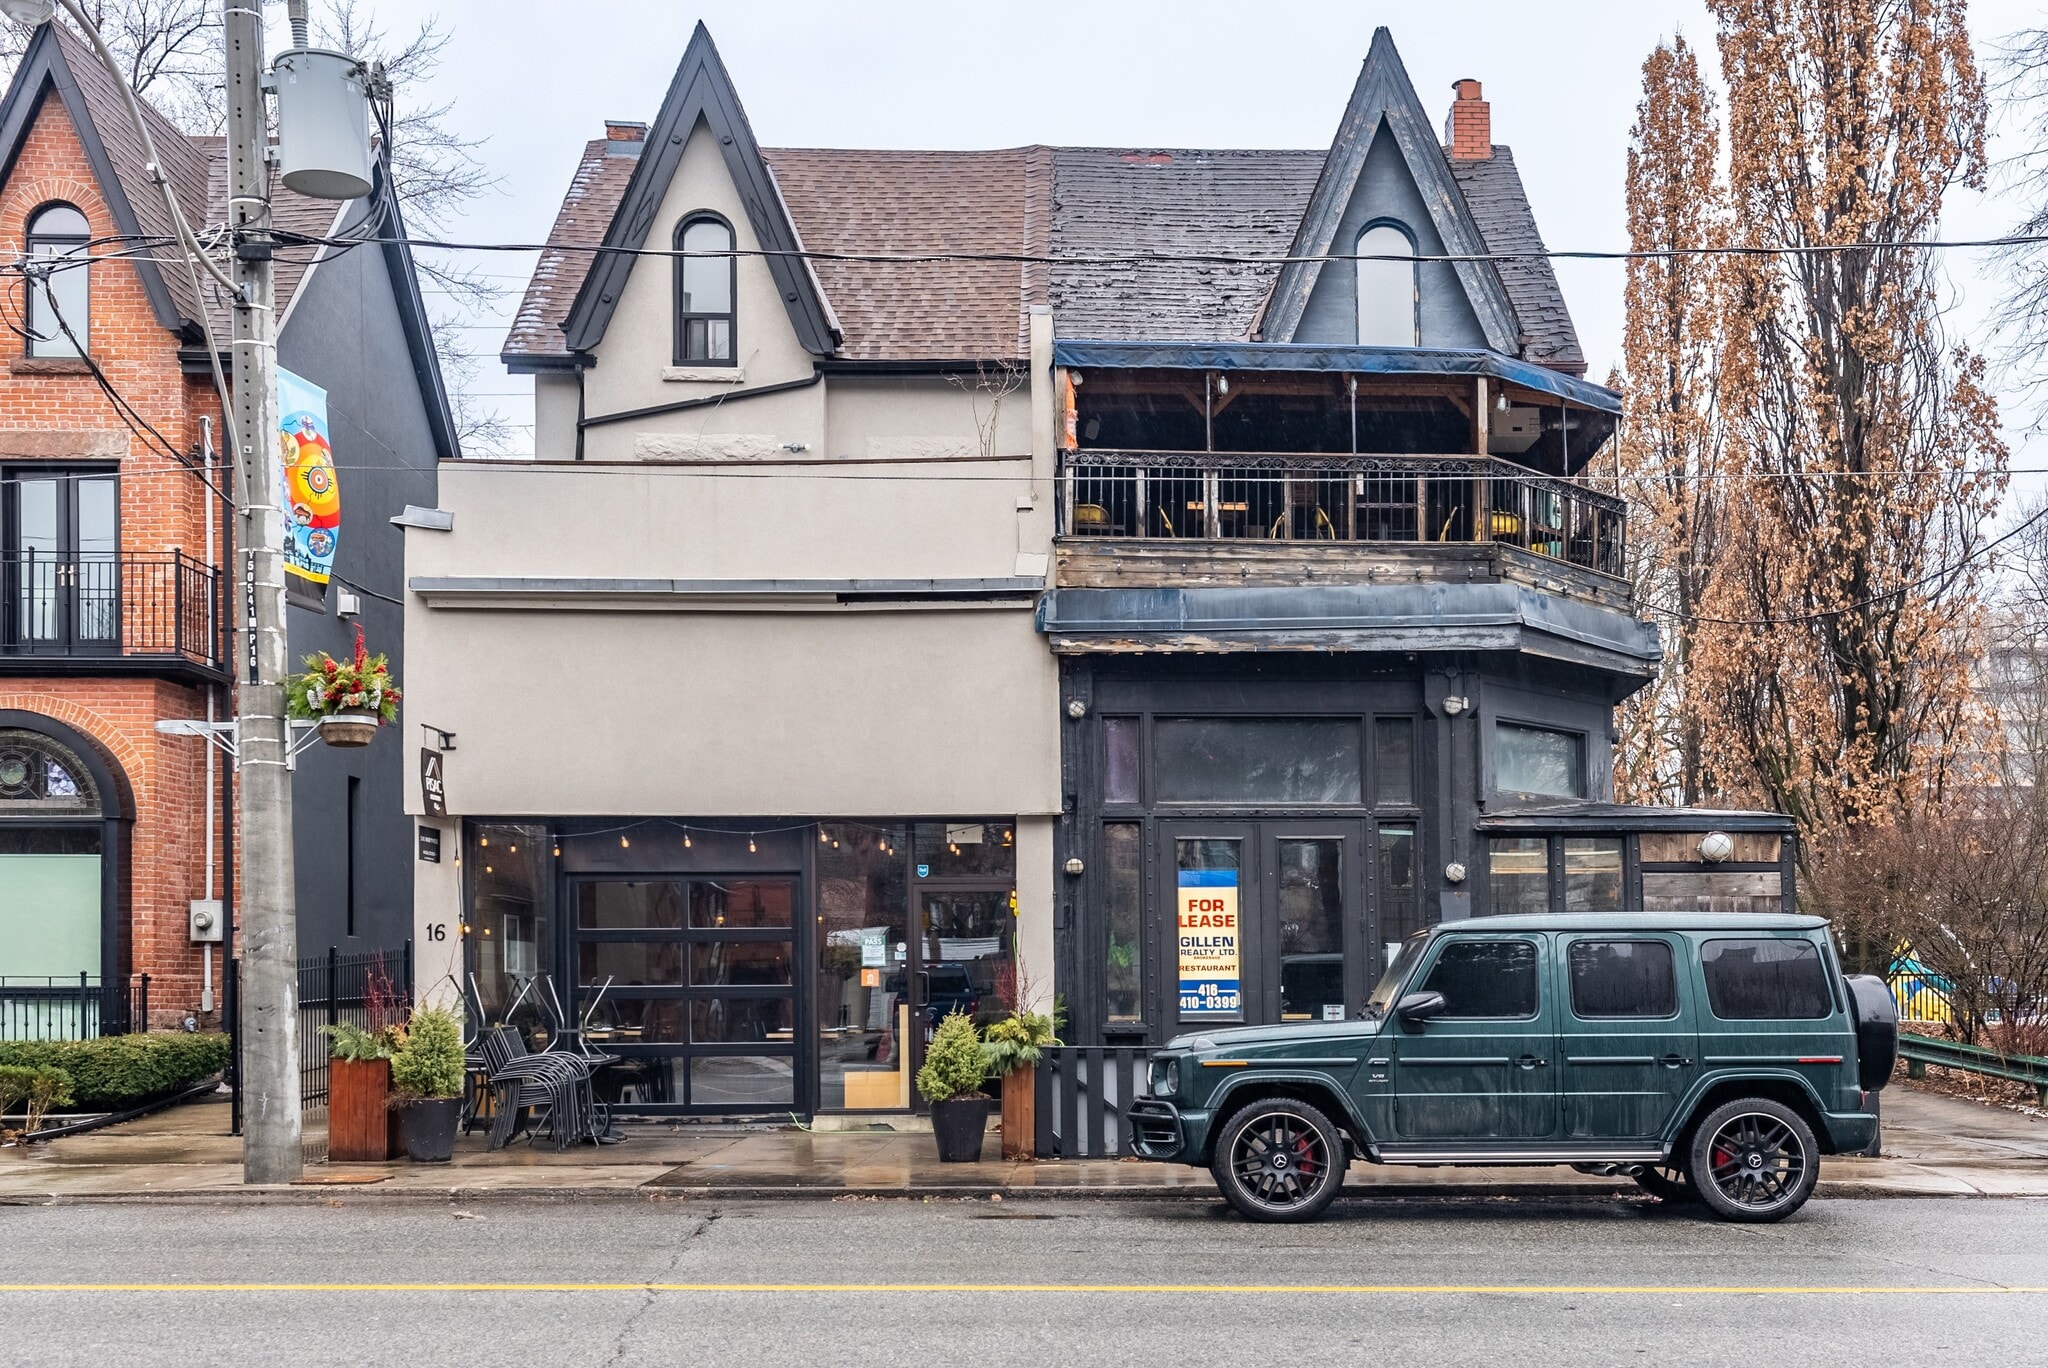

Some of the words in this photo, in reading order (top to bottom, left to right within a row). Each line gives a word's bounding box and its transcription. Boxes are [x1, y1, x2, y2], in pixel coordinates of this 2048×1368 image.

[1188, 899, 1224, 912] FOR
[1177, 915, 1235, 928] LEASE
[426, 923, 446, 941] 16
[864, 937, 883, 946] PASS
[1180, 936, 1234, 948] GILLEN
[1178, 964, 1237, 972] RESTAURANT
[1197, 983, 1219, 997] 416
[1179, 996, 1237, 1009] 410-0399
